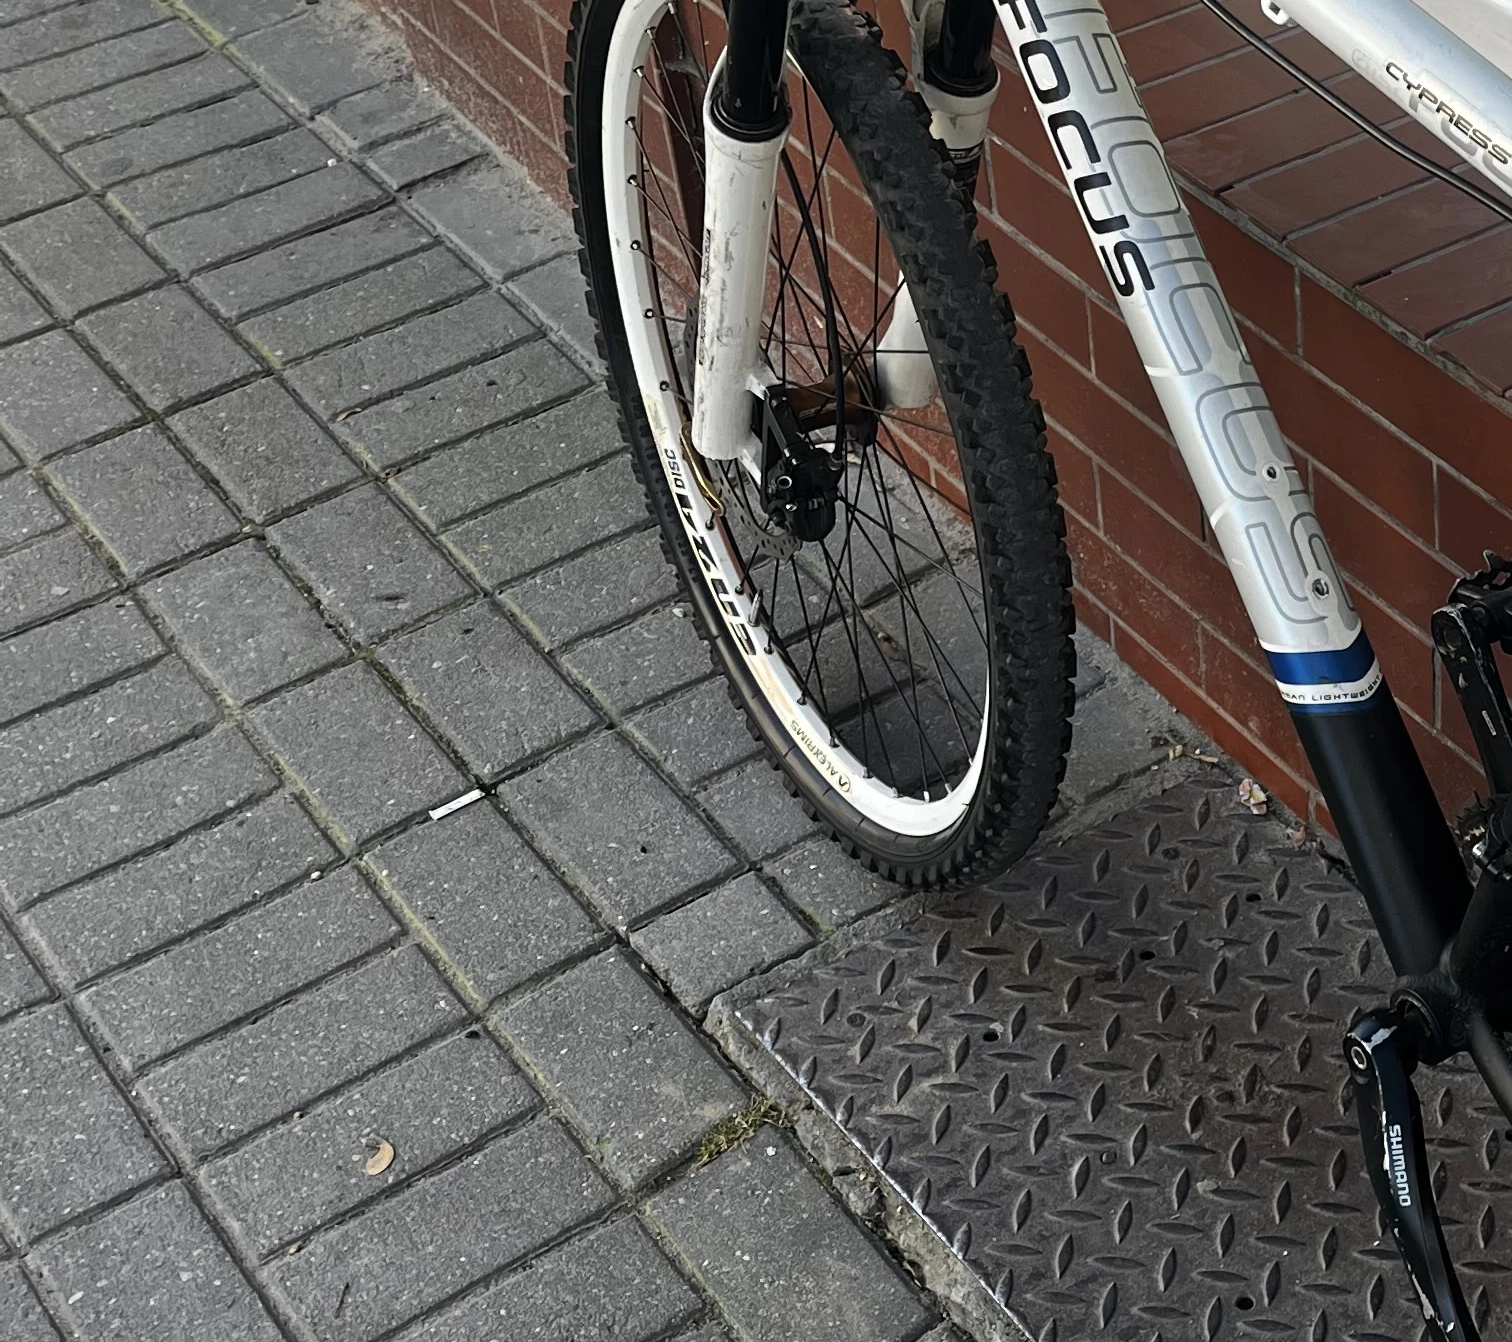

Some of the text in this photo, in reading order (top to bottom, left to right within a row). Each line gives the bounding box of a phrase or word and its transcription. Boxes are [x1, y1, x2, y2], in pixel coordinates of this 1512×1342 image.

[1385, 61, 1512, 165] CYPRESS
[663, 448, 686, 490] DISC
[790, 719, 839, 777] ALEXRIMS
[1388, 1124, 1412, 1207] SHIMANO
